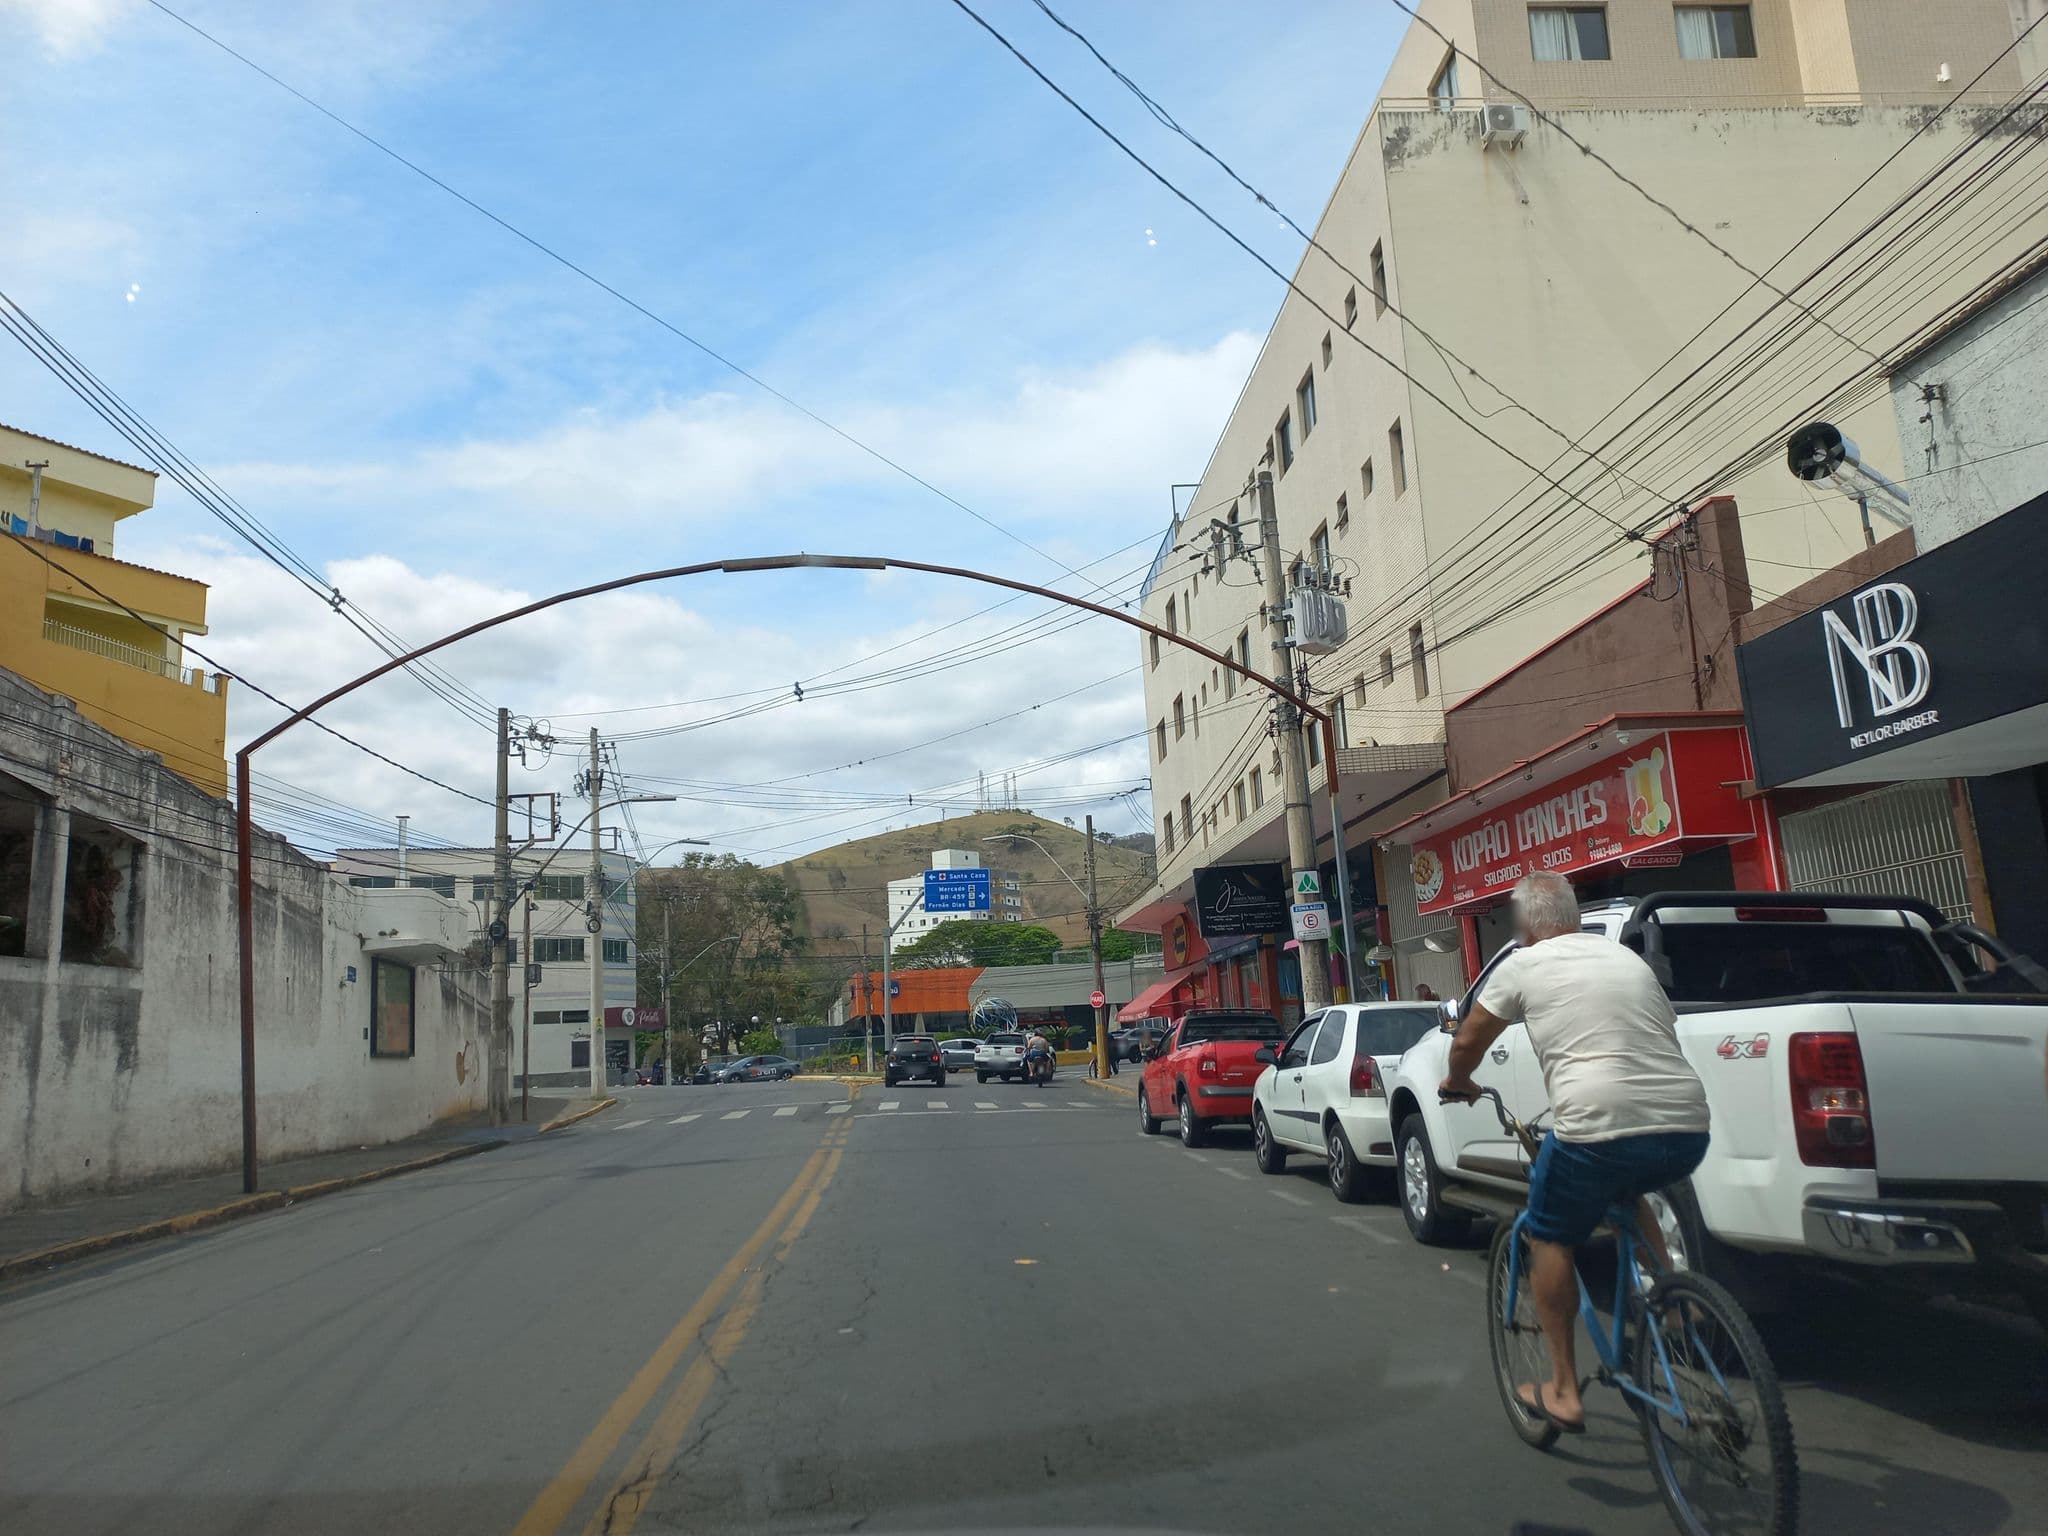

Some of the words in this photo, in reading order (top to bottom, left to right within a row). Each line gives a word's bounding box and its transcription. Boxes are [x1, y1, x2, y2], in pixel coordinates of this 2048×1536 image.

[1850, 725, 1894, 749] NEYLOR
[1893, 710, 1939, 736] BARBER
[1451, 818, 1510, 874] KOPÃO
[1515, 780, 1608, 853] LANCHES
[1484, 863, 1522, 888] SALGADOS
[1528, 860, 1536, 873] &
[1542, 846, 1573, 870] SUCOS
[1632, 856, 1678, 865] SALGADOS
[1307, 916, 1315, 926] E
